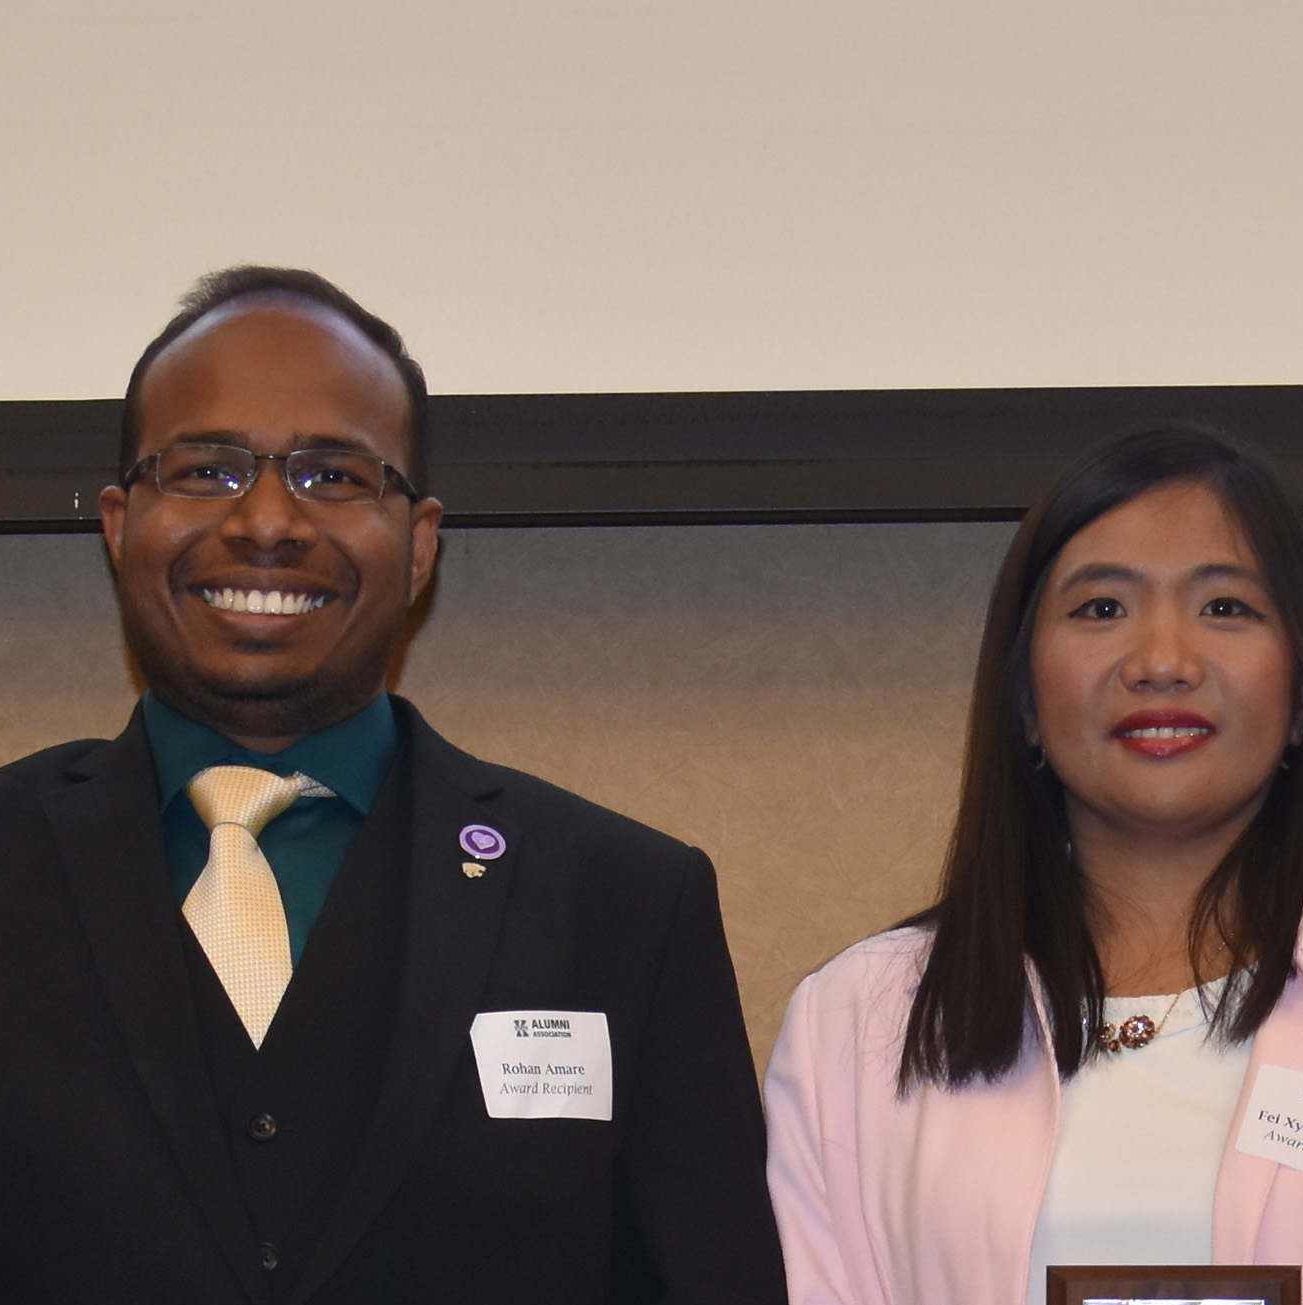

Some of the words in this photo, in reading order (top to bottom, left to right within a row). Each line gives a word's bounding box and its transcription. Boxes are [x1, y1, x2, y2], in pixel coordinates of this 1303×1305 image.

[531, 1019, 571, 1030] ALUMNI
[532, 1030, 572, 1038] ASSOCIATION
[502, 1062, 541, 1075] Rohan
[545, 1063, 585, 1075] Amare
[499, 1082, 539, 1095] Award
[542, 1082, 593, 1097] Recipient
[1257, 1109, 1280, 1125] Fei
